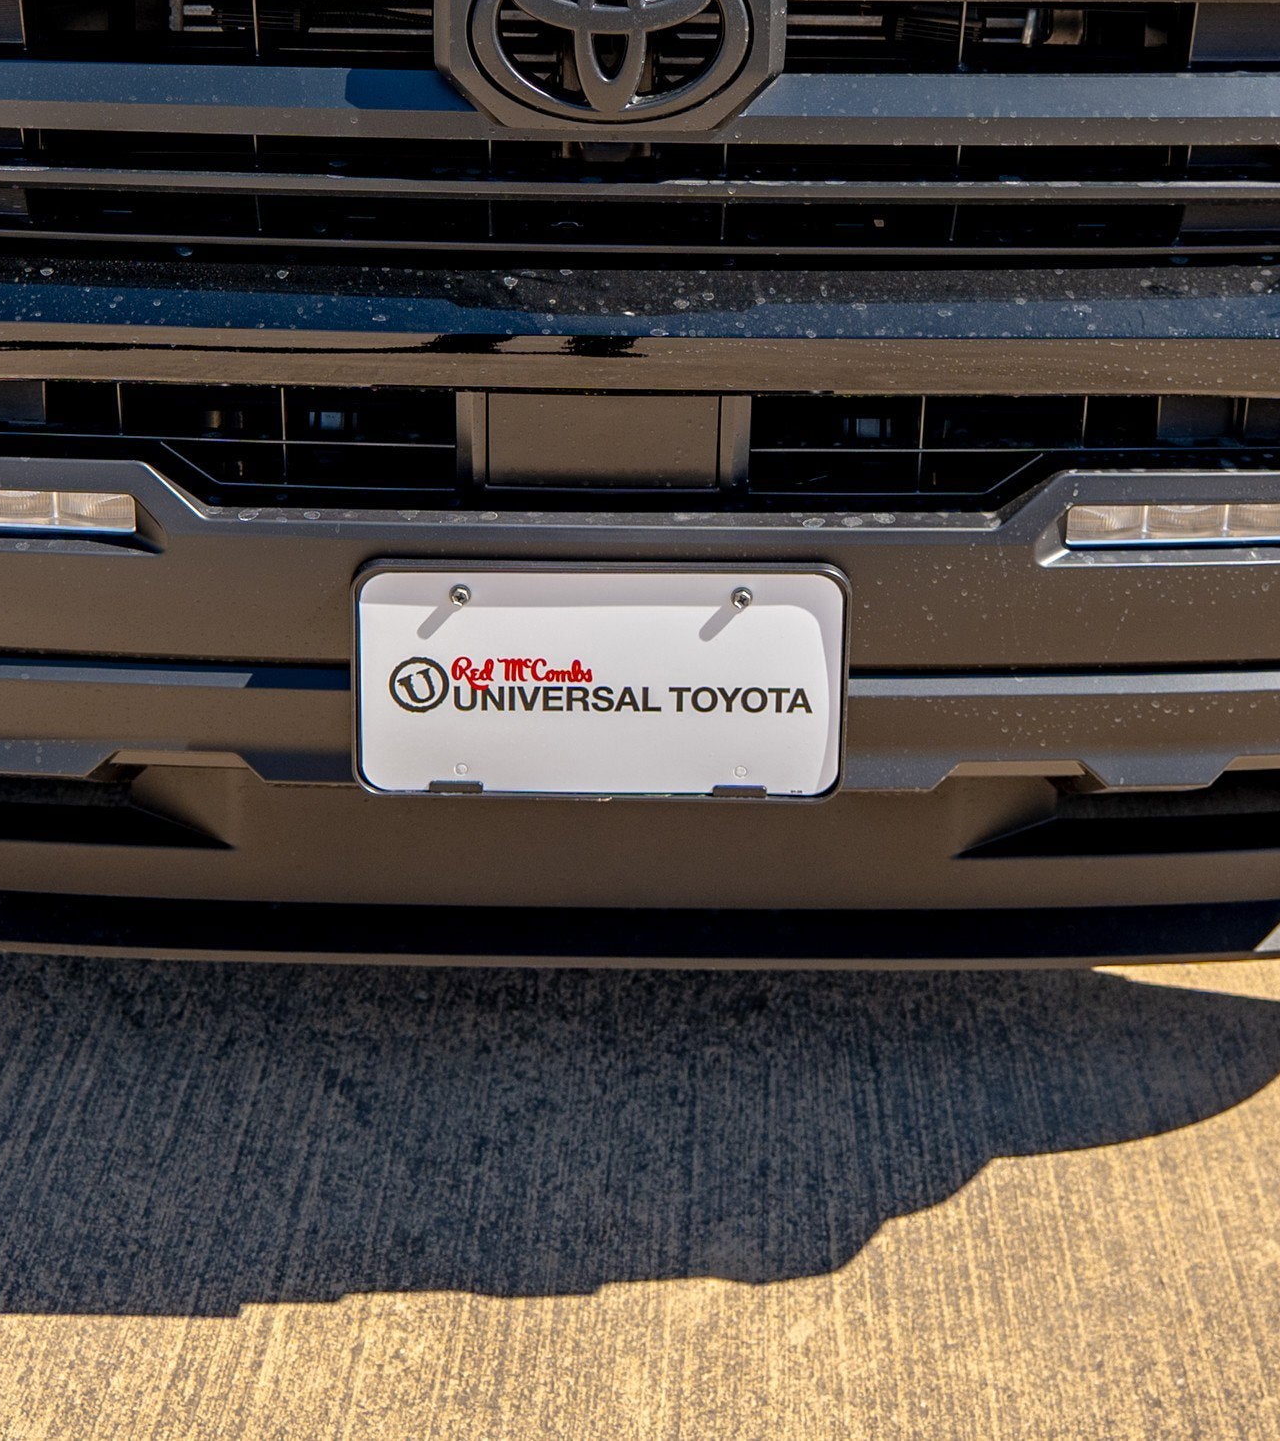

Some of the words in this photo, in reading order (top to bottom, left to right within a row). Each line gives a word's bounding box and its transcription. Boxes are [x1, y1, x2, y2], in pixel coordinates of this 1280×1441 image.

[451, 656, 494, 690] Red
[497, 658, 593, 684] McCombs
[453, 685, 662, 713] UNIVERSAL
[669, 686, 813, 715] TOYOTA
